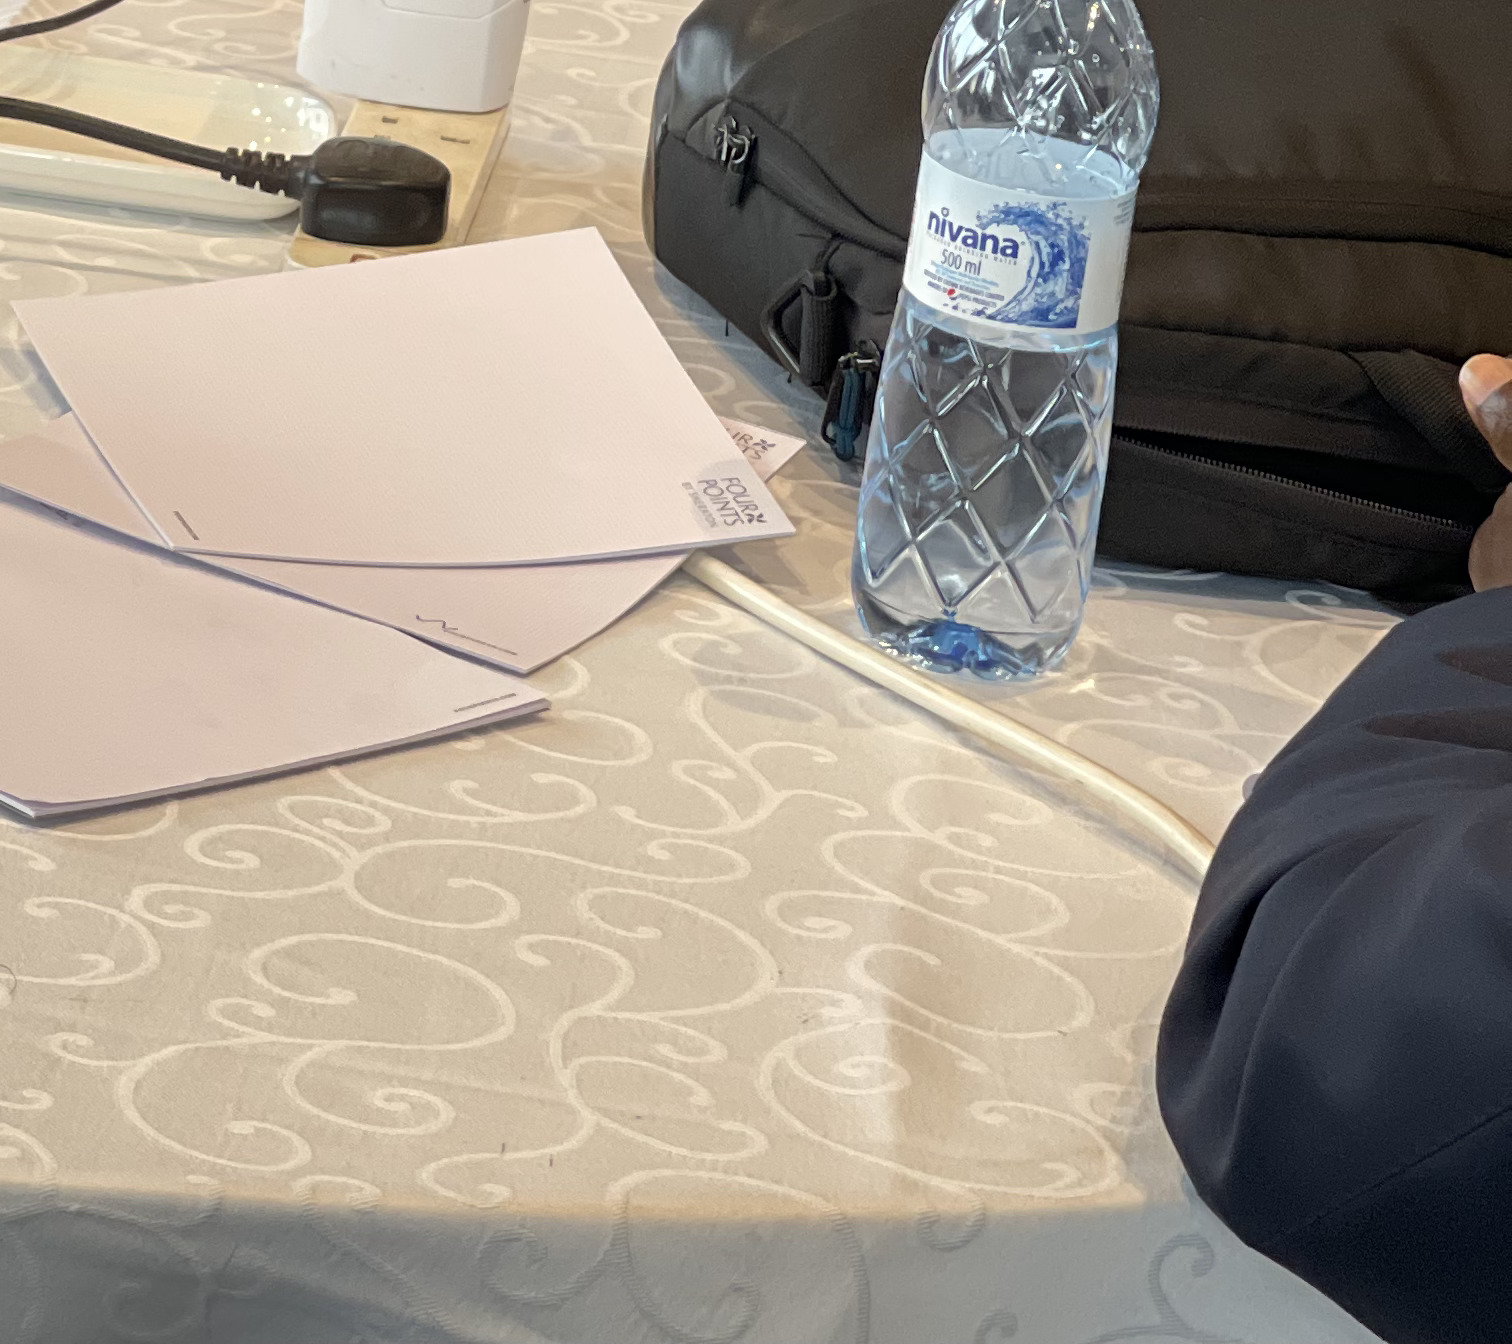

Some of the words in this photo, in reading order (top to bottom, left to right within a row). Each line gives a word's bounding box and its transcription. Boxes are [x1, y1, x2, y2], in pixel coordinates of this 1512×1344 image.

[927, 206, 1019, 259] nivana
[940, 248, 963, 271] 500
[964, 258, 983, 277] ml
[697, 479, 744, 526] POINTS
[720, 477, 758, 514] FOUR
